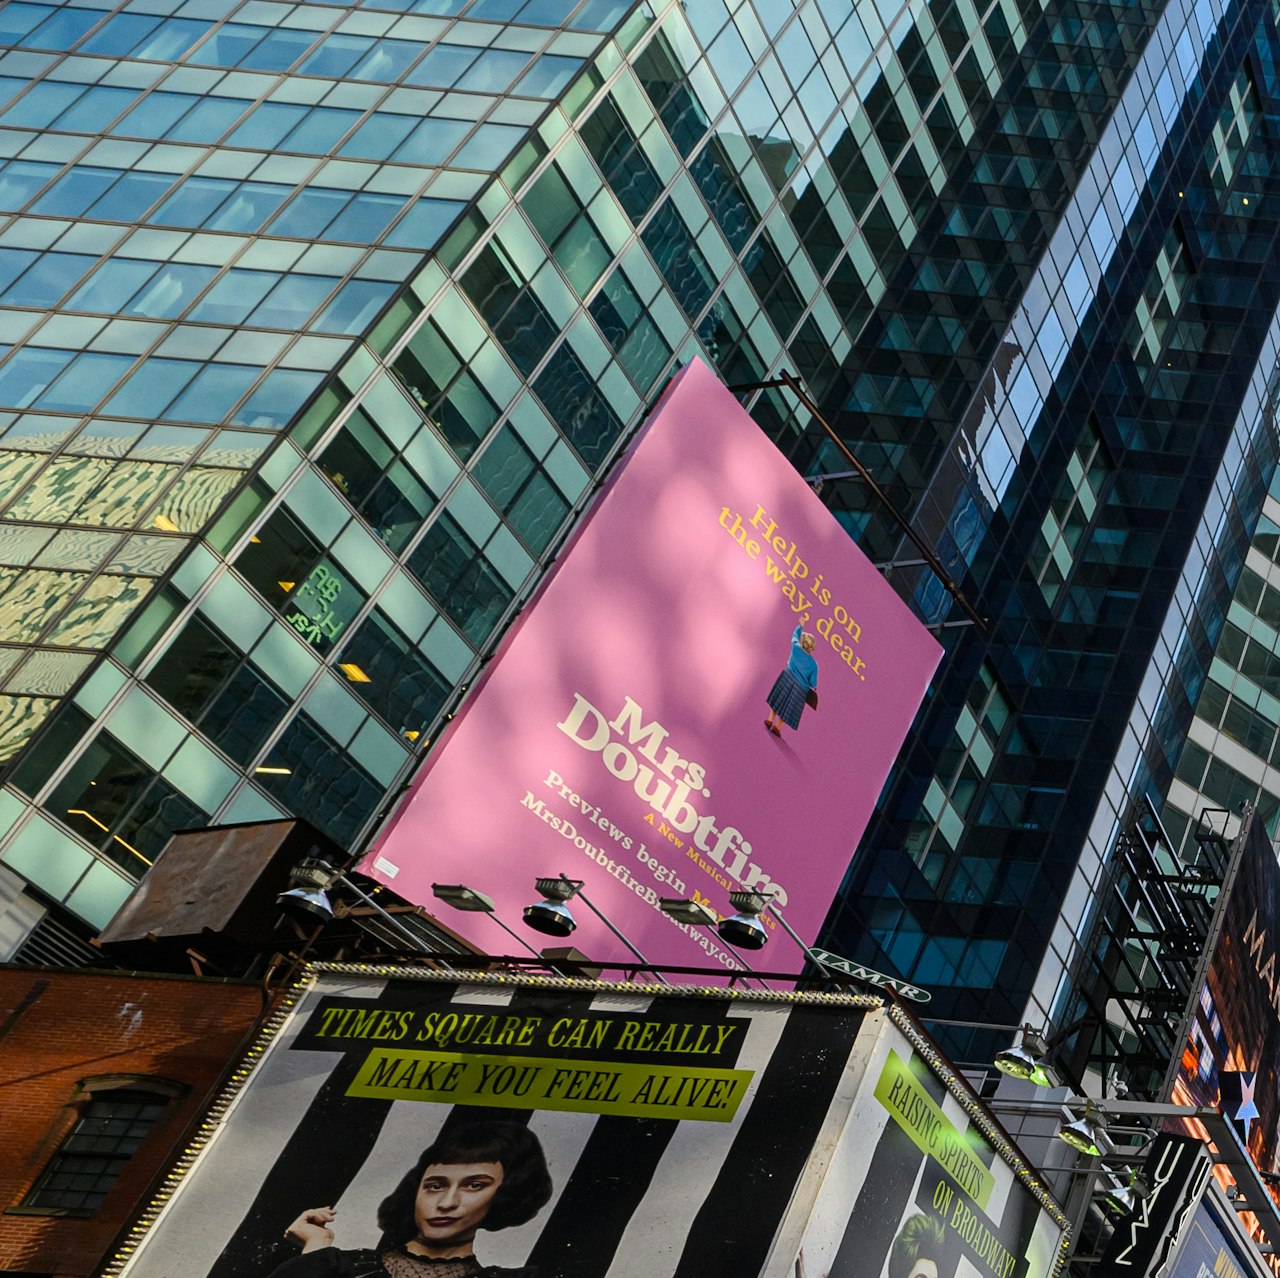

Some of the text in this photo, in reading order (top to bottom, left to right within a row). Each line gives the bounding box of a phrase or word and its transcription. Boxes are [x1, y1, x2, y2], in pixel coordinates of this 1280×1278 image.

[719, 505, 867, 681] the way, dear.
[749, 504, 863, 642] Help is on
[608, 696, 711, 798] Mrs.
[543, 768, 687, 895] Previews begin
[557, 692, 789, 915] Doubtfire
[643, 812, 733, 892] A New Musical
[816, 952, 920, 998] LAMAR
[314, 1007, 739, 1056] TIMES SQUARE CAN REALLY
[364, 1057, 738, 1109] MAKE YOU FEEL ALIVE!
[887, 1071, 985, 1201] RAISING SPIRITS
[932, 1180, 952, 1217] ON
